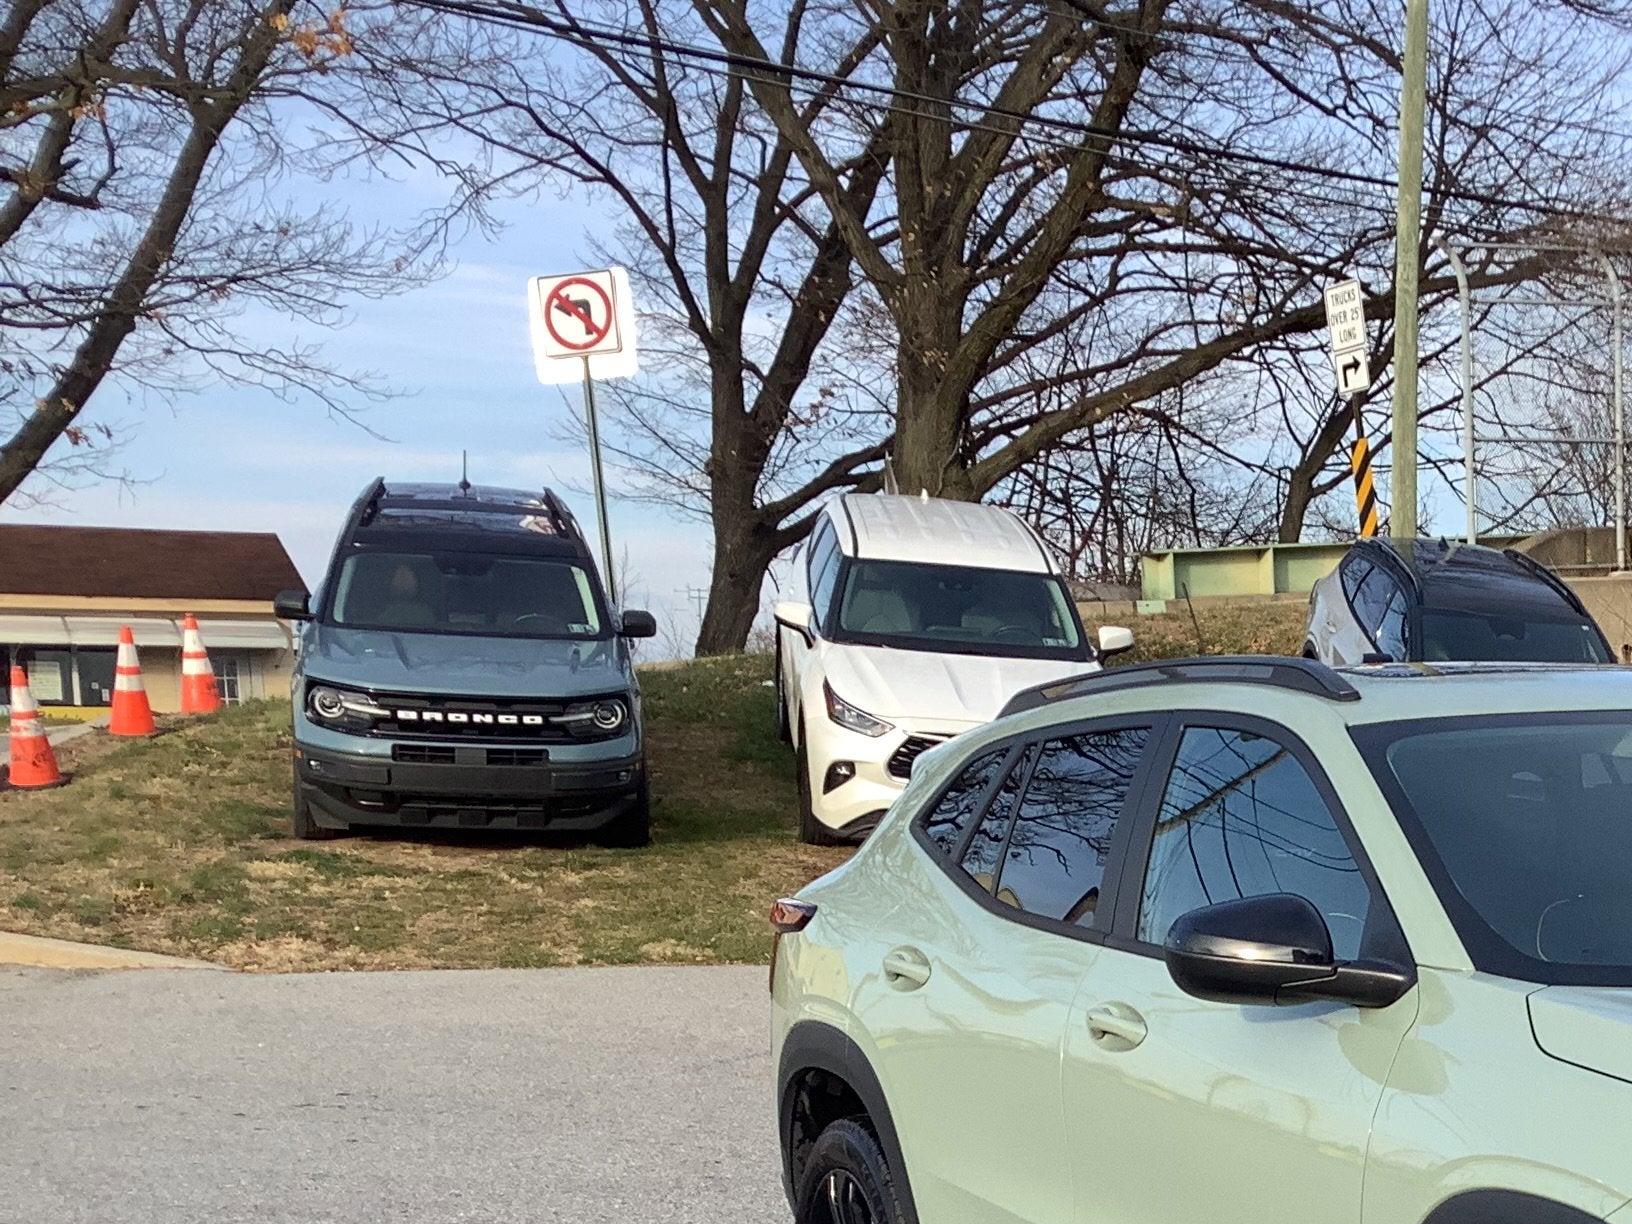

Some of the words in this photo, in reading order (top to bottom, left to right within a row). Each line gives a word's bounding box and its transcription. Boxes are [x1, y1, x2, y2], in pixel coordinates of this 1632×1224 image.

[1331, 289, 1355, 306] TRUCKS
[1331, 310, 1347, 326] OVER
[1339, 327, 1356, 343] LONG
[397, 710, 543, 724] BRONCO
